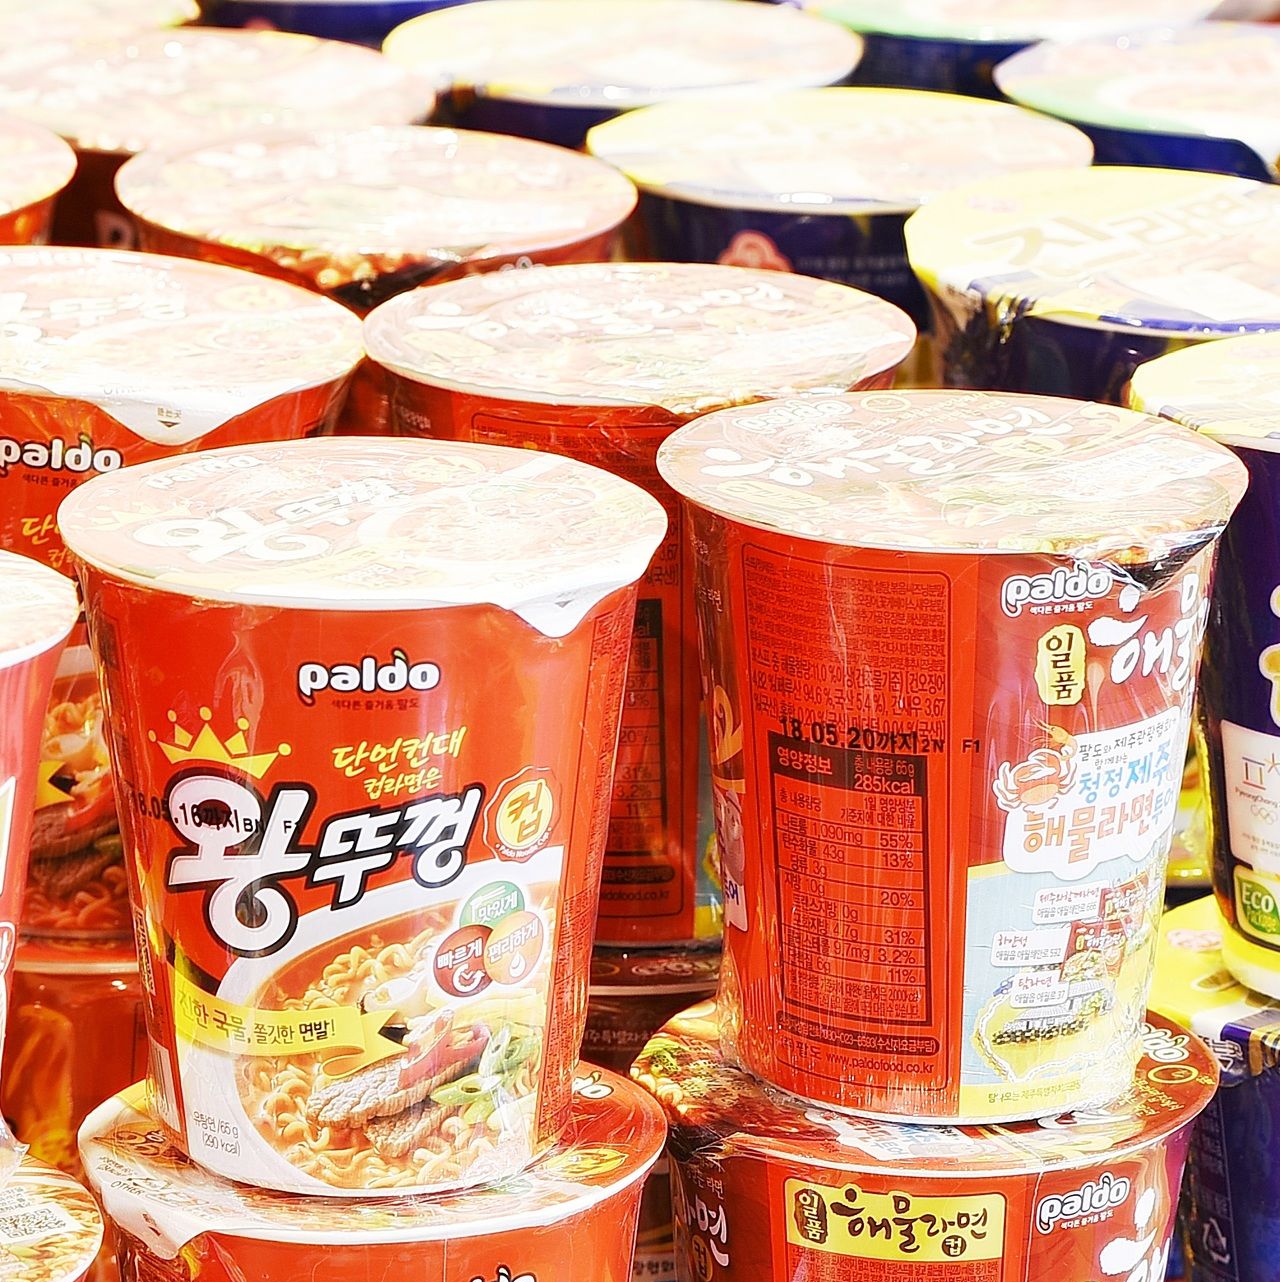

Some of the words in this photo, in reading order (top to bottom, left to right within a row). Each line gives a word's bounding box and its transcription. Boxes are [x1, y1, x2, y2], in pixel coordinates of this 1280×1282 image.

[1004, 572, 1111, 618] paldo
[298, 650, 441, 705] paldo
[1043, 630, 1078, 701] 일품
[332, 726, 467, 778] 단언컨대
[777, 746, 833, 775] 영양정보
[363, 771, 443, 800] 컵라면은
[854, 774, 915, 794] 285kcal
[880, 834, 913, 848] 55%
[1023, 789, 1154, 865] 해물라면
[167, 774, 481, 953] 왕뚜껑
[823, 844, 845, 863] 43g
[882, 853, 914, 868] 13%
[880, 891, 914, 906] 20%
[437, 936, 484, 970] 빠르게
[884, 930, 916, 945] 31%
[878, 949, 916, 964] 3.2%
[887, 969, 916, 983] 11%
[1038, 1175, 1131, 1234] paldo
[829, 1191, 988, 1255] 해물라면
